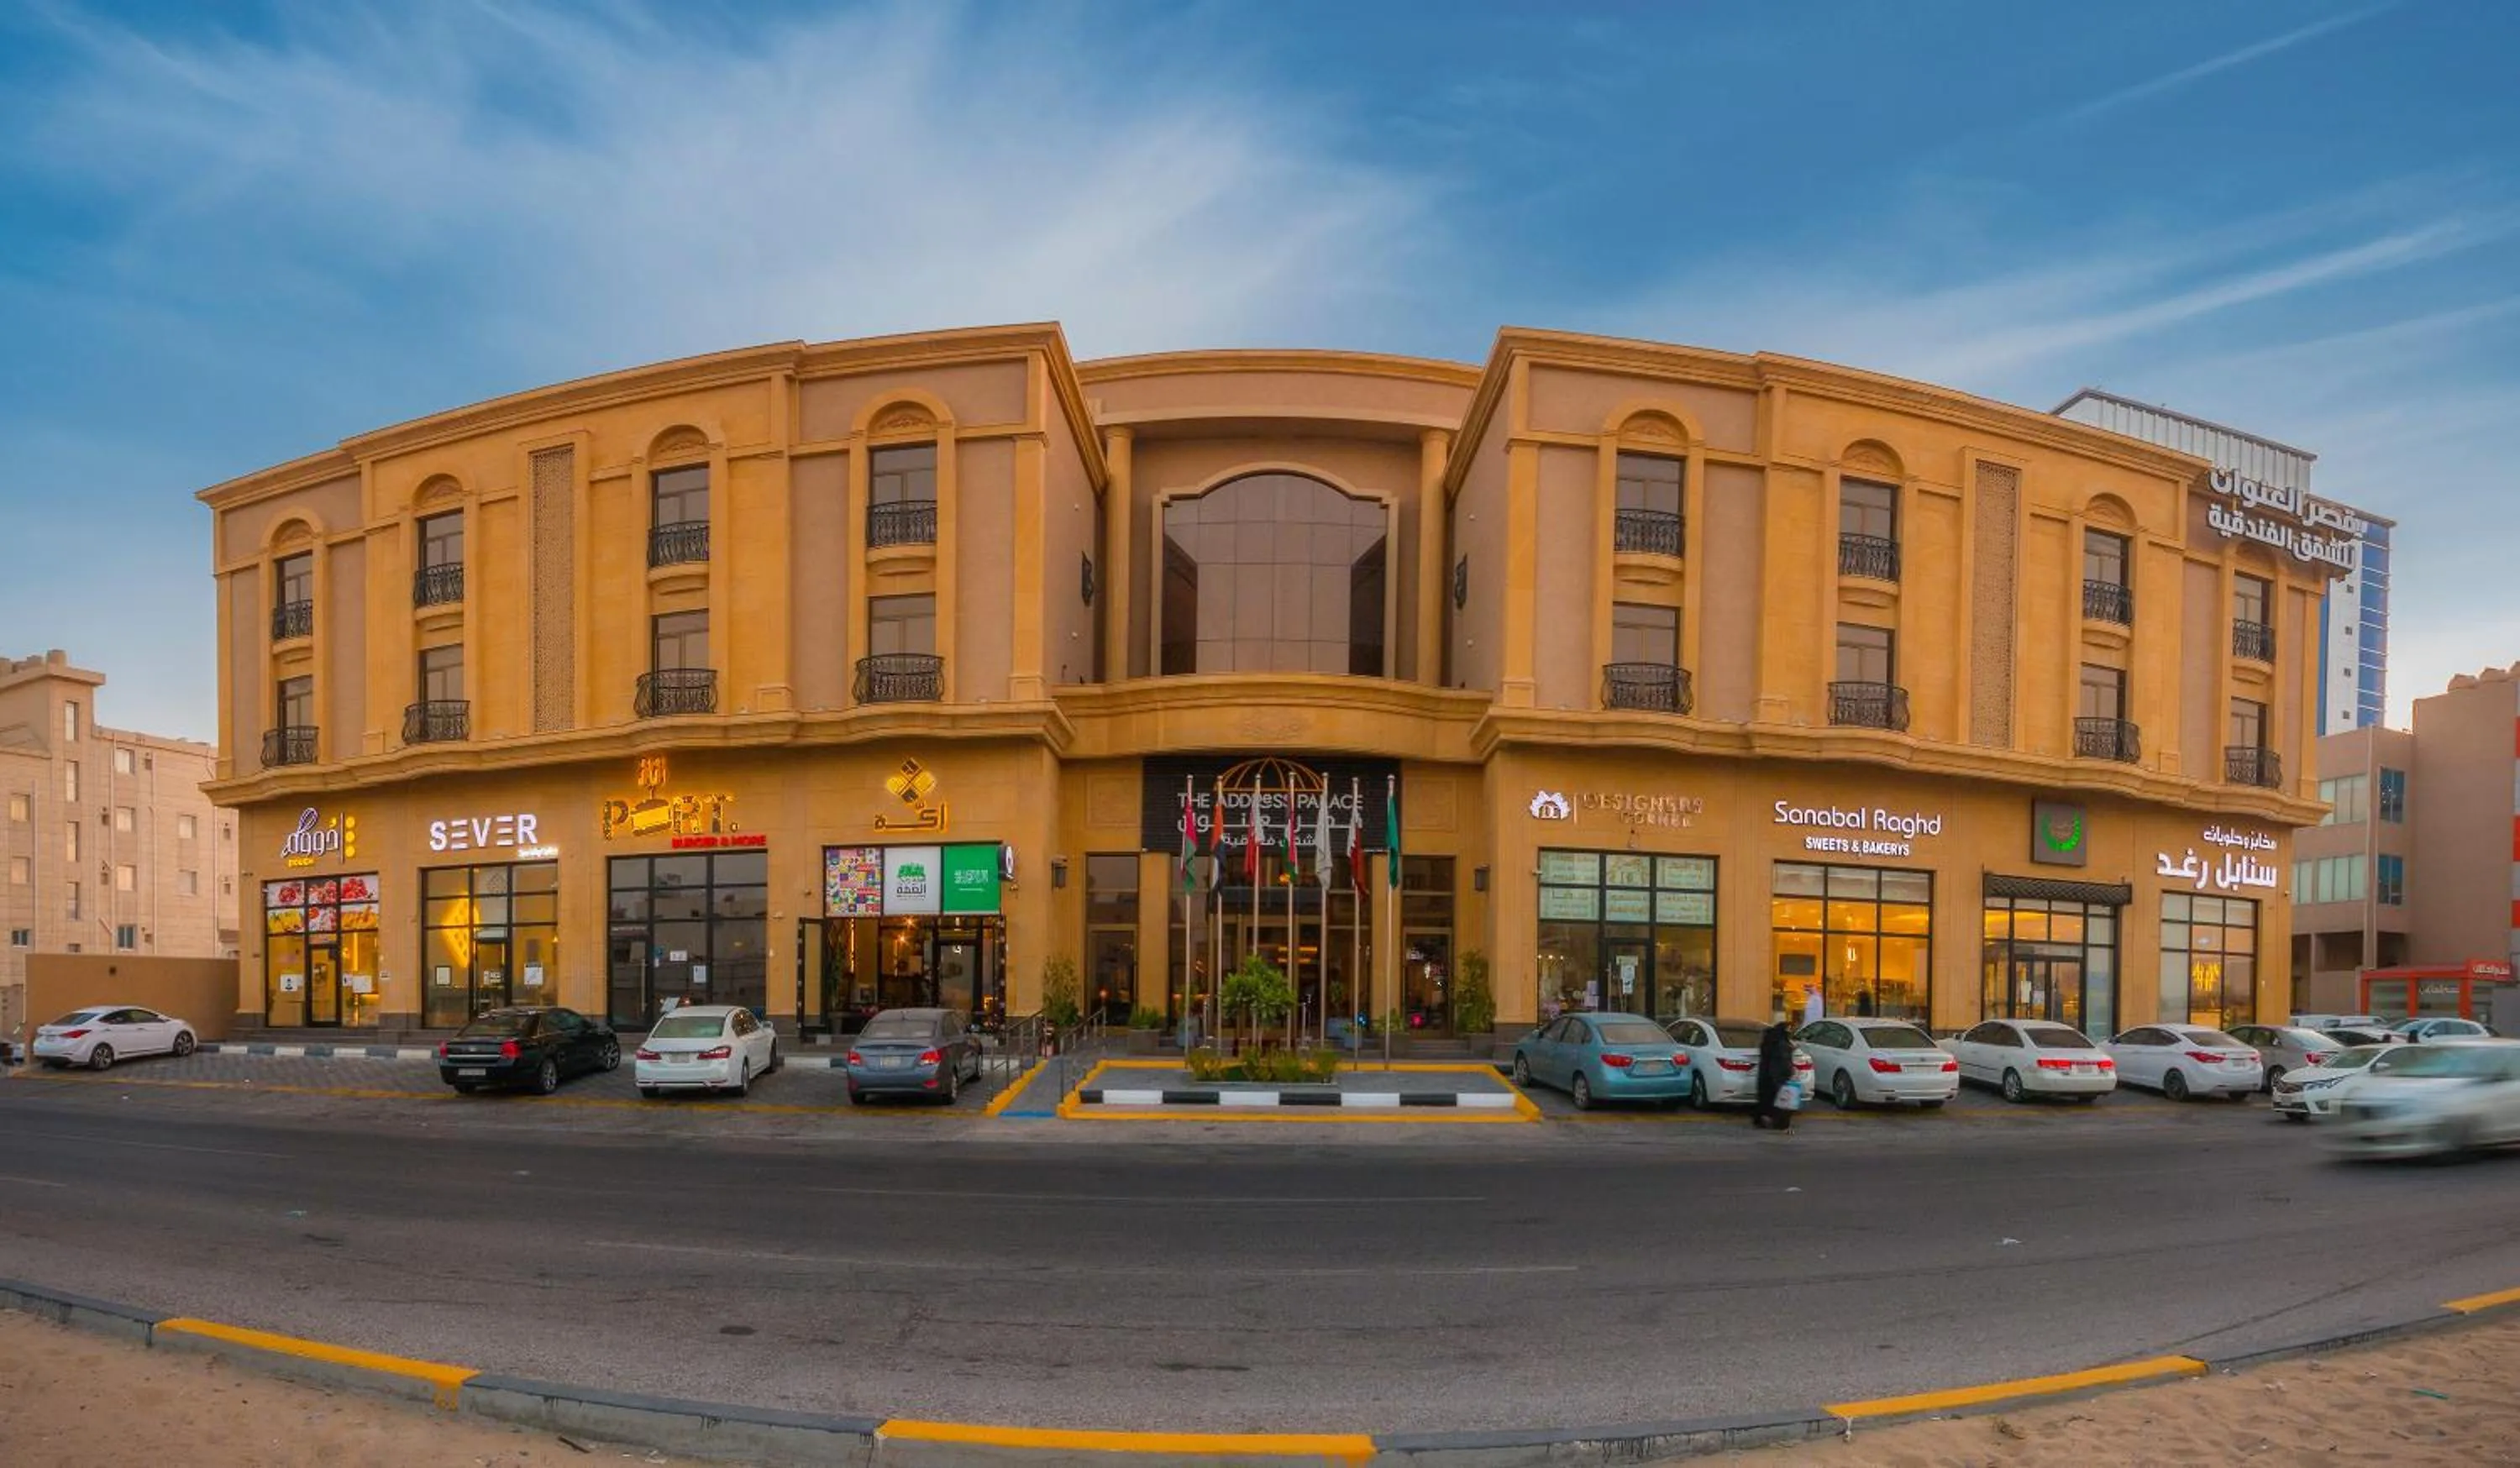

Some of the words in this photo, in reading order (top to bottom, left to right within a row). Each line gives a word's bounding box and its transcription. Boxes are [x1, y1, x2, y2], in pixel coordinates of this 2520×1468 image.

[2208, 504, 2292, 551] الفندقية
[1298, 793, 1363, 810] PAACE
[1774, 800, 1866, 829] Sanabal
[1873, 809, 1941, 839] Raghd
[429, 814, 538, 851] SEVER
[1805, 836, 1849, 852] SWEETS
[1851, 840, 1860, 853] &
[1862, 841, 1909, 857] BAKERYS
[2157, 848, 2208, 889] رغد
[2216, 852, 2277, 890] سنابل
